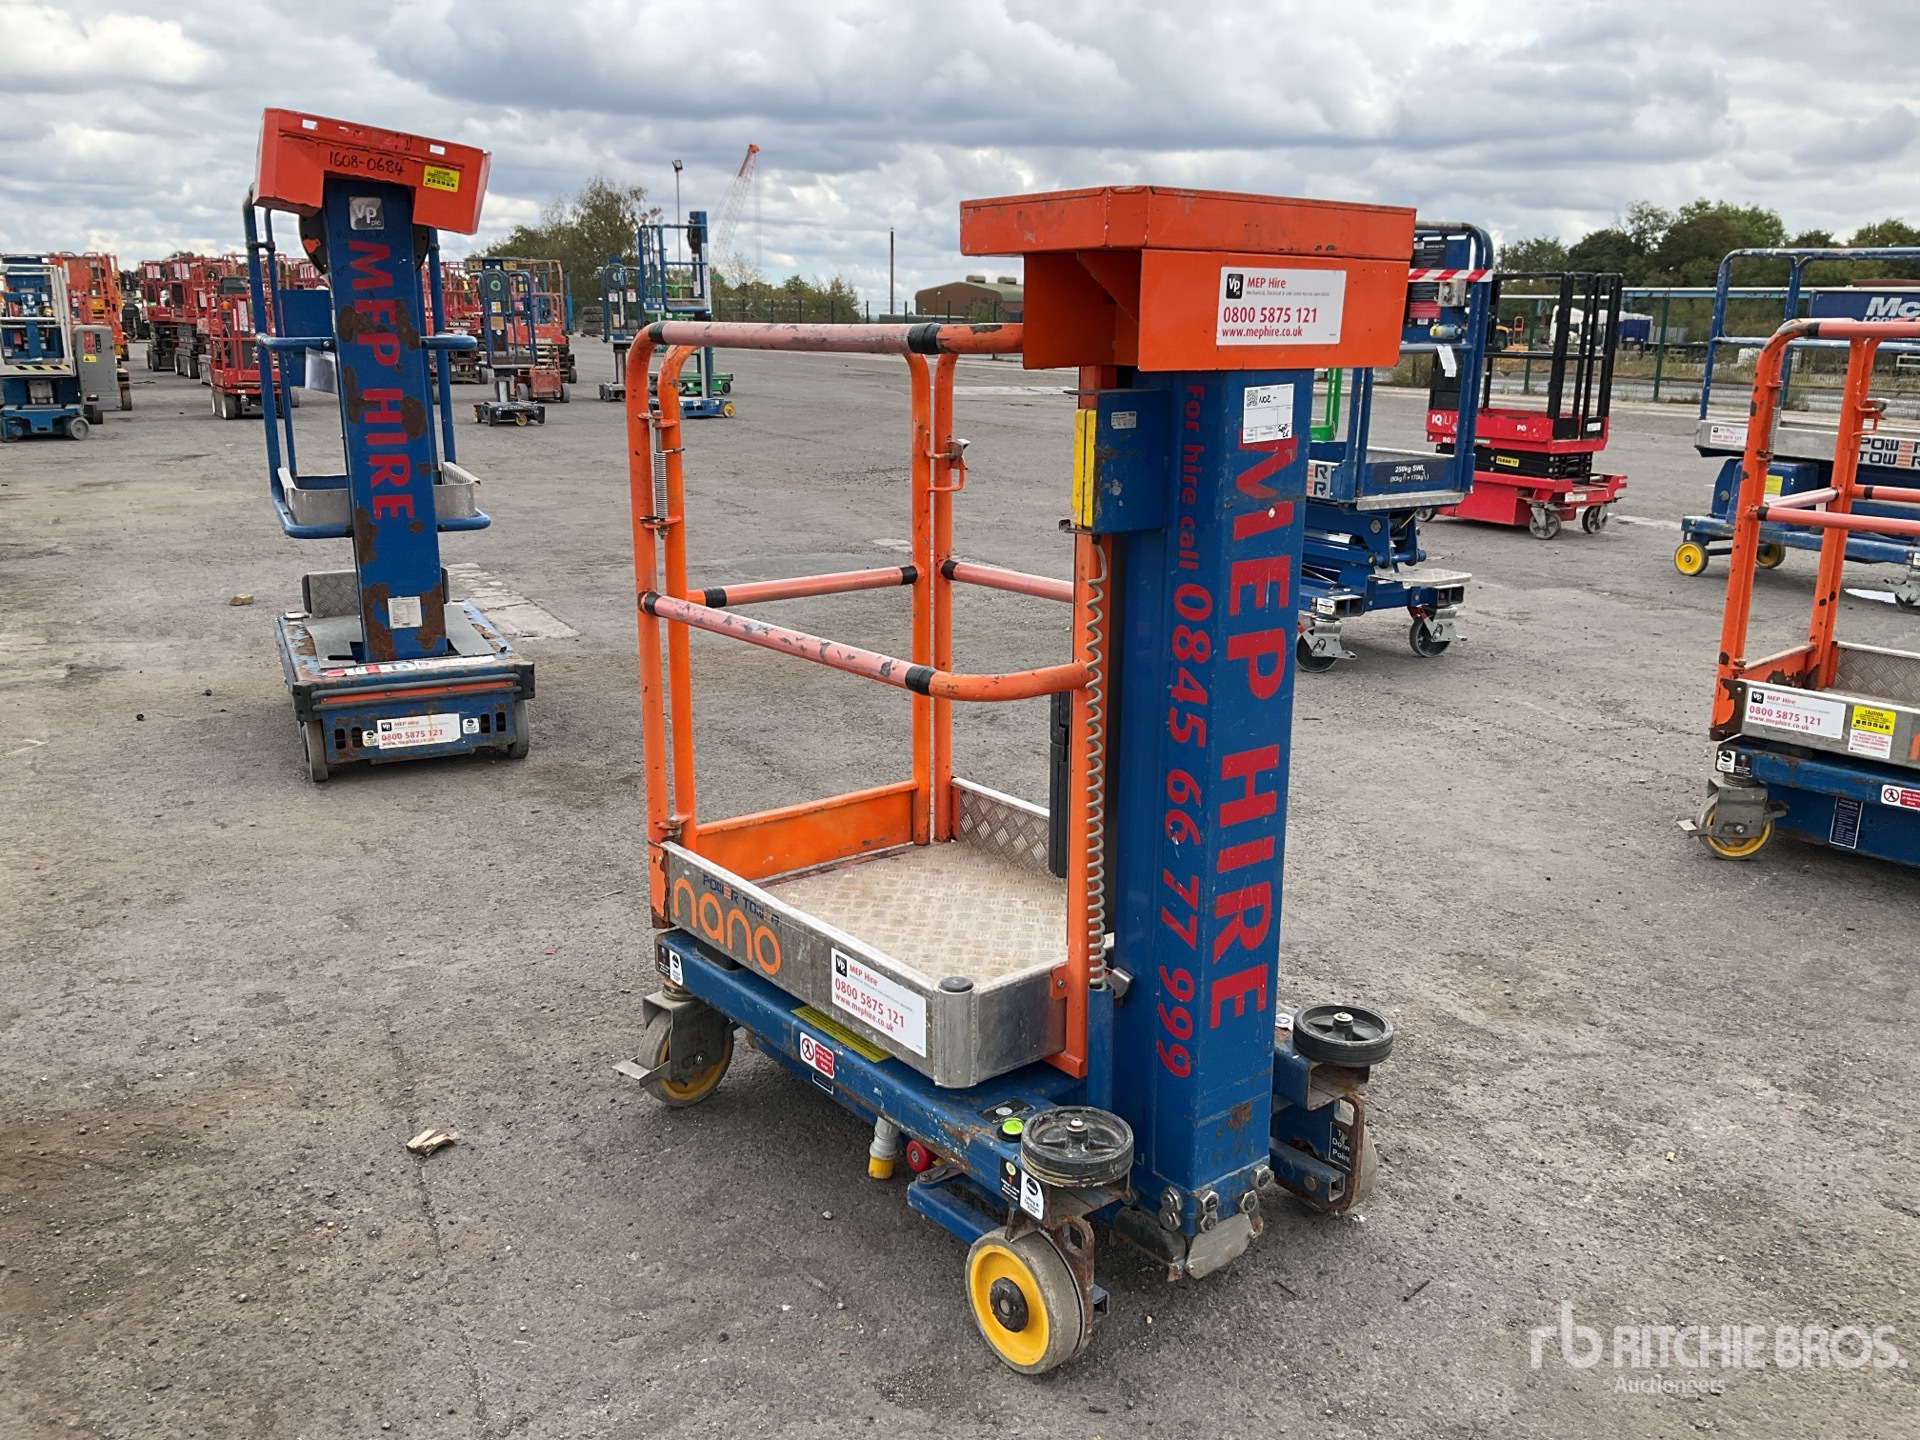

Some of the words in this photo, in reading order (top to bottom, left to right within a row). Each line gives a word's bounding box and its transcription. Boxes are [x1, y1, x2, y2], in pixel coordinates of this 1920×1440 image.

[329, 151, 403, 176] 1608-0684
[1247, 277, 1266, 288] MEP
[1268, 277, 1286, 289] Hire
[1222, 326, 1303, 339] www.mephire.co.uk
[1223, 306, 1255, 323] 0800
[1260, 307, 1291, 323] 5875
[1296, 307, 1317, 323] 121
[1184, 384, 1205, 433] For
[361, 388, 415, 520] HIRE
[1180, 444, 1205, 506] hire
[1178, 518, 1199, 569] call
[1226, 428, 1299, 699] MEP
[1168, 583, 1213, 747] 0845
[381, 732, 402, 740] 0800
[405, 730, 425, 738] 5875
[429, 729, 443, 737] 121
[1748, 714, 1809, 730] www.mephire.co.uk
[1749, 705, 1773, 716] 0800
[1776, 710, 1800, 722] 5875
[1804, 715, 1821, 726] 121
[1164, 769, 1201, 845] 66
[703, 874, 739, 904] POWER
[1160, 868, 1200, 950] 77
[1209, 744, 1280, 1030] HIRE
[673, 877, 782, 975] nano
[849, 965, 862, 977] MEP
[864, 973, 878, 986] Hire
[835, 977, 857, 1000] 0800
[860, 993, 883, 1015] 5875
[887, 1008, 904, 1028] 121
[835, 993, 893, 1032] www.mephire.co.uk
[1155, 965, 1196, 1078] 999
